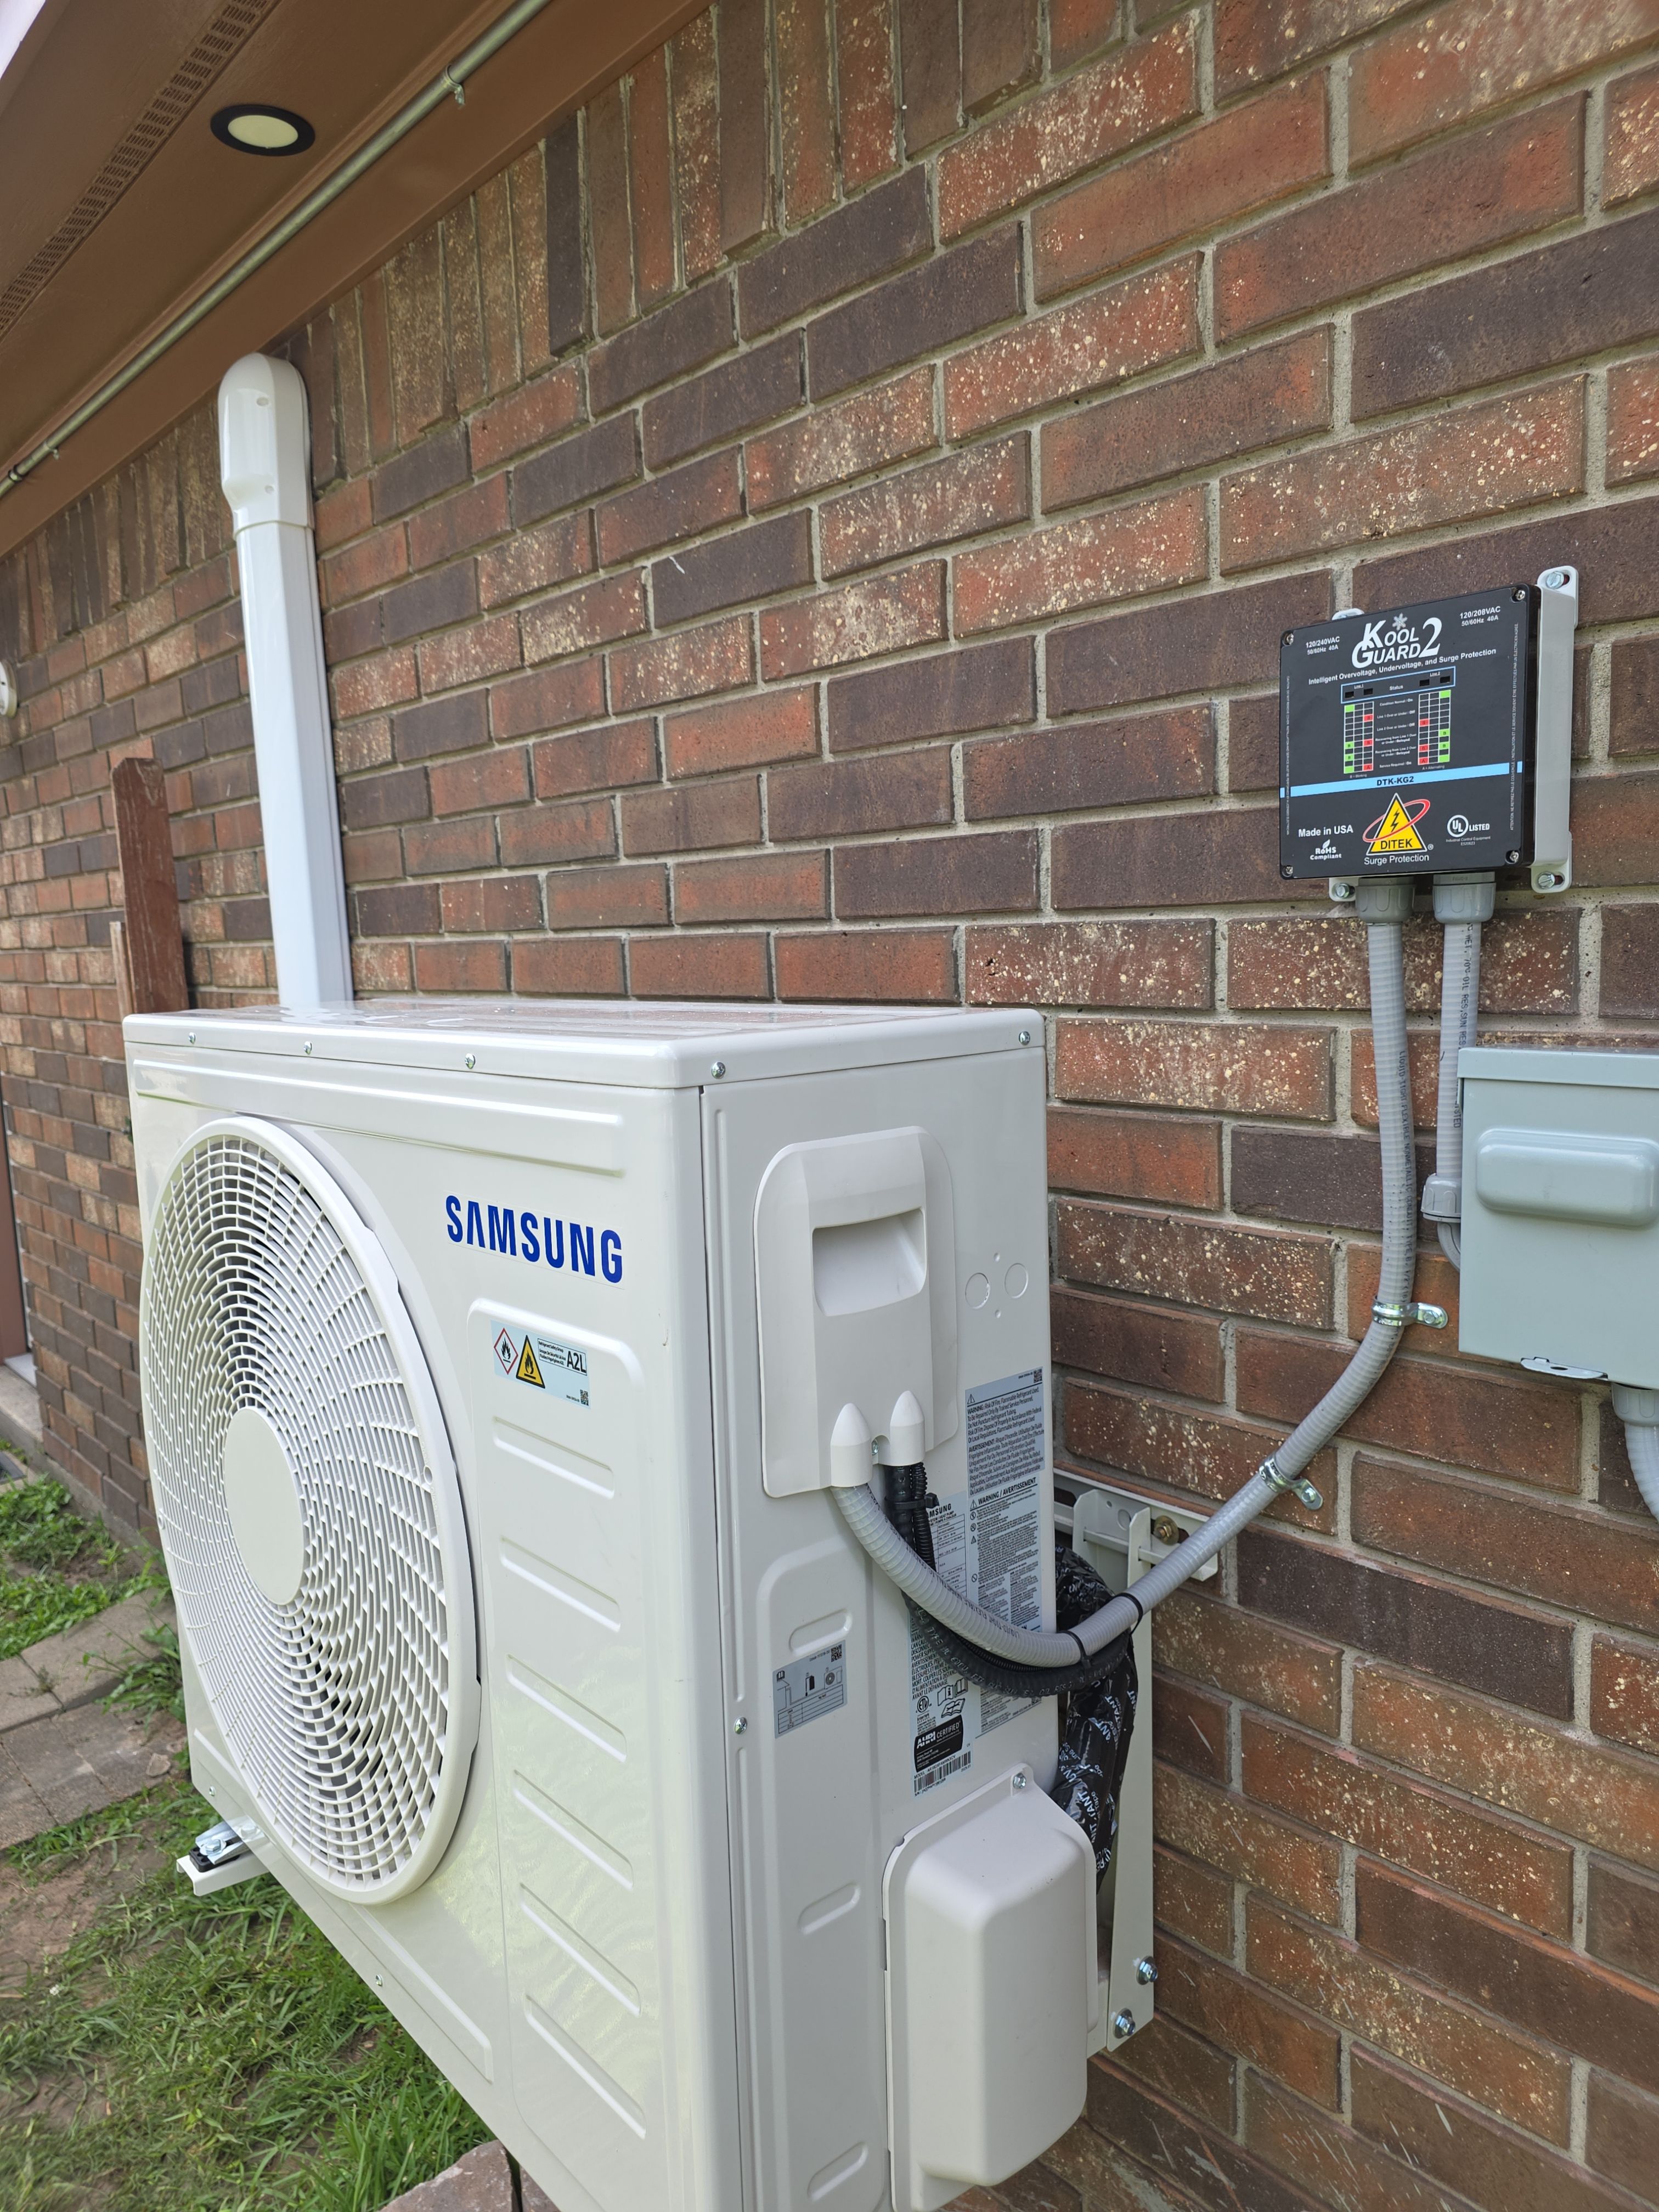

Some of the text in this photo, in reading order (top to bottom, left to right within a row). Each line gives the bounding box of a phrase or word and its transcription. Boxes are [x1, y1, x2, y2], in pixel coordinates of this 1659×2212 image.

[1460, 606, 1500, 619] 120/208VAC
[1306, 636, 1340, 648] 120/240VAC
[1308, 674, 1338, 685] Intelligent
[1339, 668, 1378, 680] Overvoltage,
[1379, 661, 1423, 673] Undervoltage,
[1460, 648, 1497, 659] Protection
[1377, 776, 1414, 786] DTK-KG2
[1299, 825, 1353, 837] Made in USA
[1452, 820, 1490, 833] UL LISTED
[1381, 838, 1413, 849] DITEK
[1316, 847, 1336, 855] RoHS
[1364, 854, 1429, 866] Surge Protection
[1401, 1104, 1410, 1140] FLEXIBLE
[1401, 1142, 1414, 1192] NONMETALLIC
[446, 1195, 622, 1283] SAMSUNG
[566, 1349, 586, 1373] A2L
[978, 1491, 999, 1505] WARNING
[1003, 1476, 1036, 1496] AVERTISSEMENT
[936, 1722, 959, 1739] CERTIFIED
